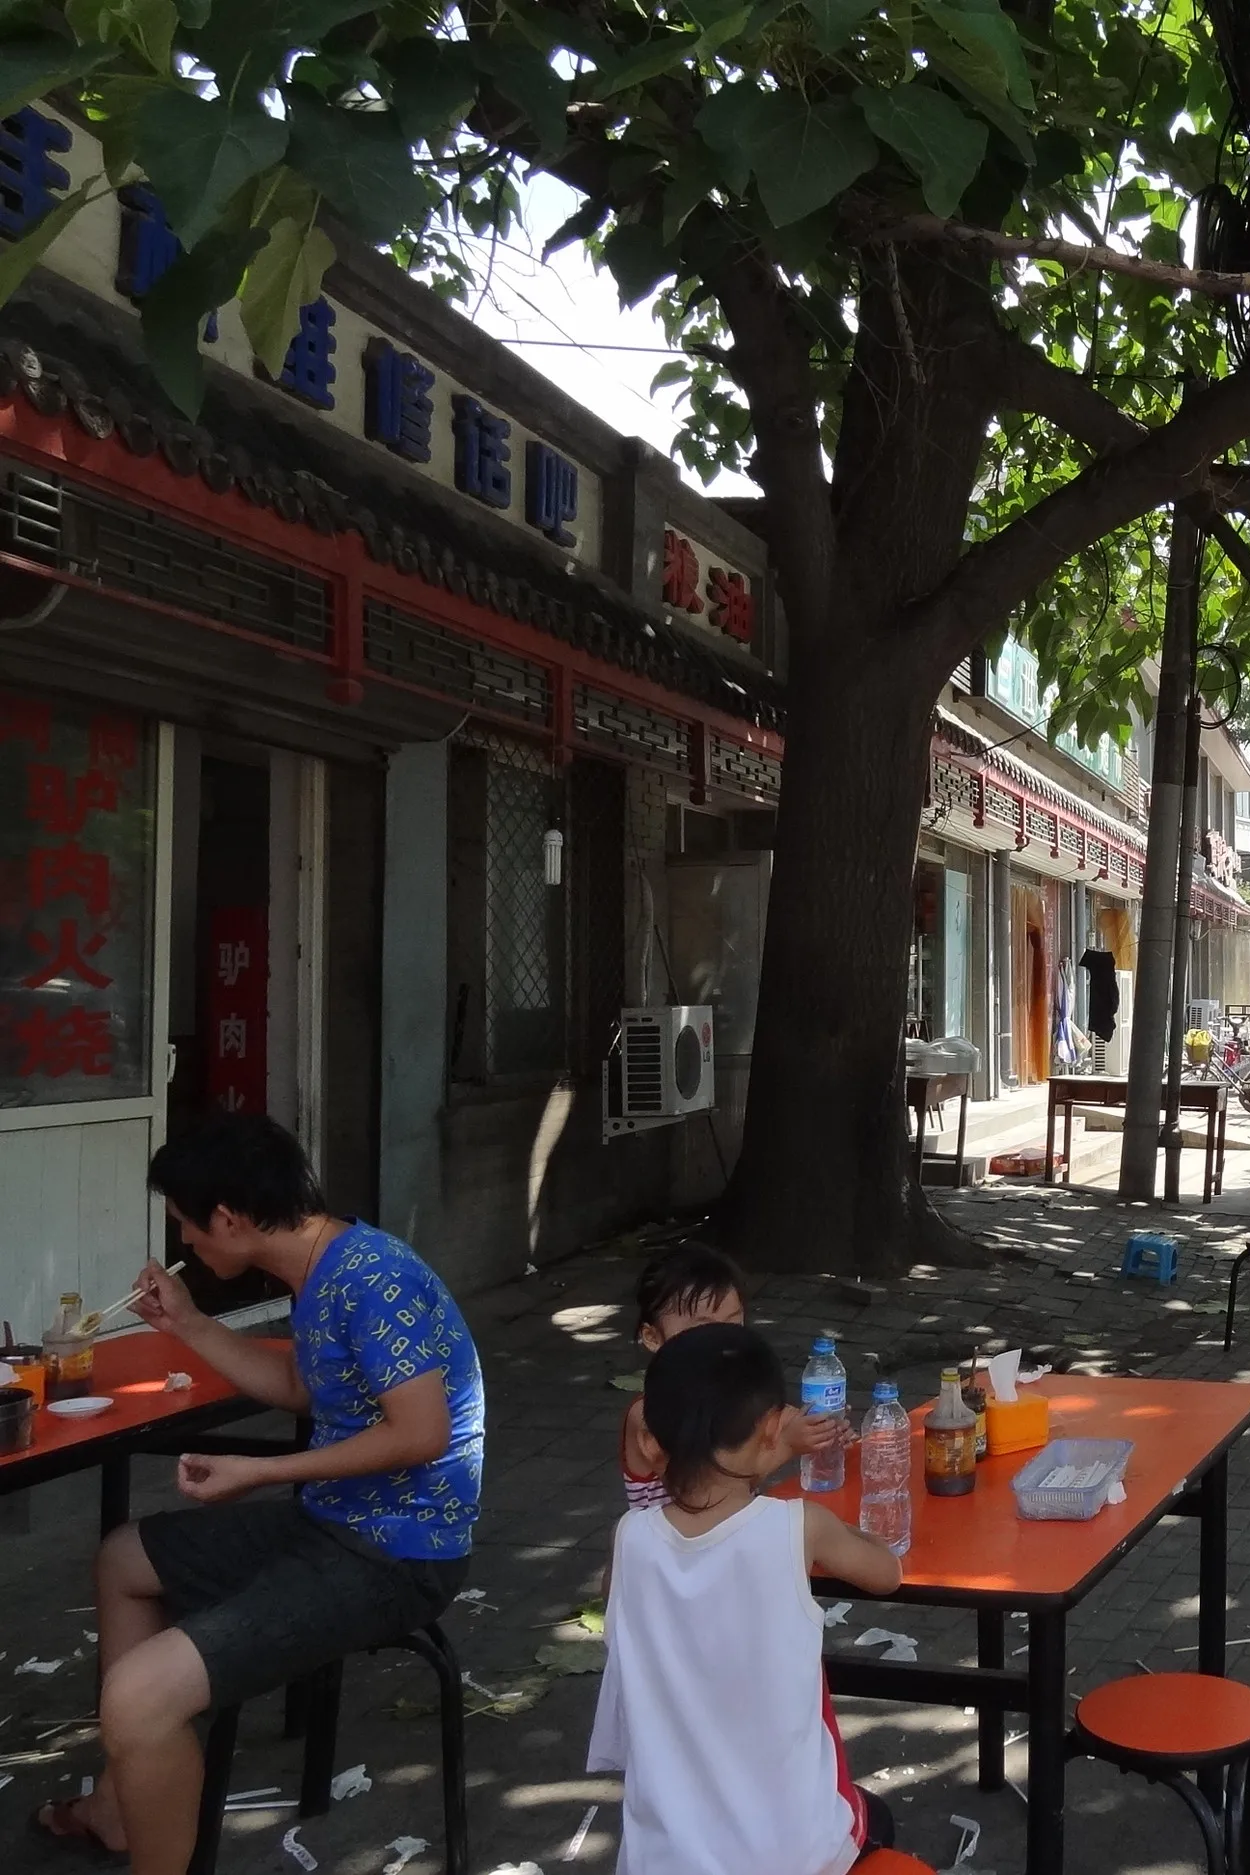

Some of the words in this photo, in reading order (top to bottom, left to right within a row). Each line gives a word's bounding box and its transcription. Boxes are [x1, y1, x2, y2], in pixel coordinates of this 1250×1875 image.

[18, 763, 119, 1078] 驴肉火烧
[396, 1309, 416, 1327] B
[371, 1319, 392, 1341] K
[391, 1336, 410, 1357] B
[415, 1340, 433, 1359] K
[396, 1359, 416, 1376] B
